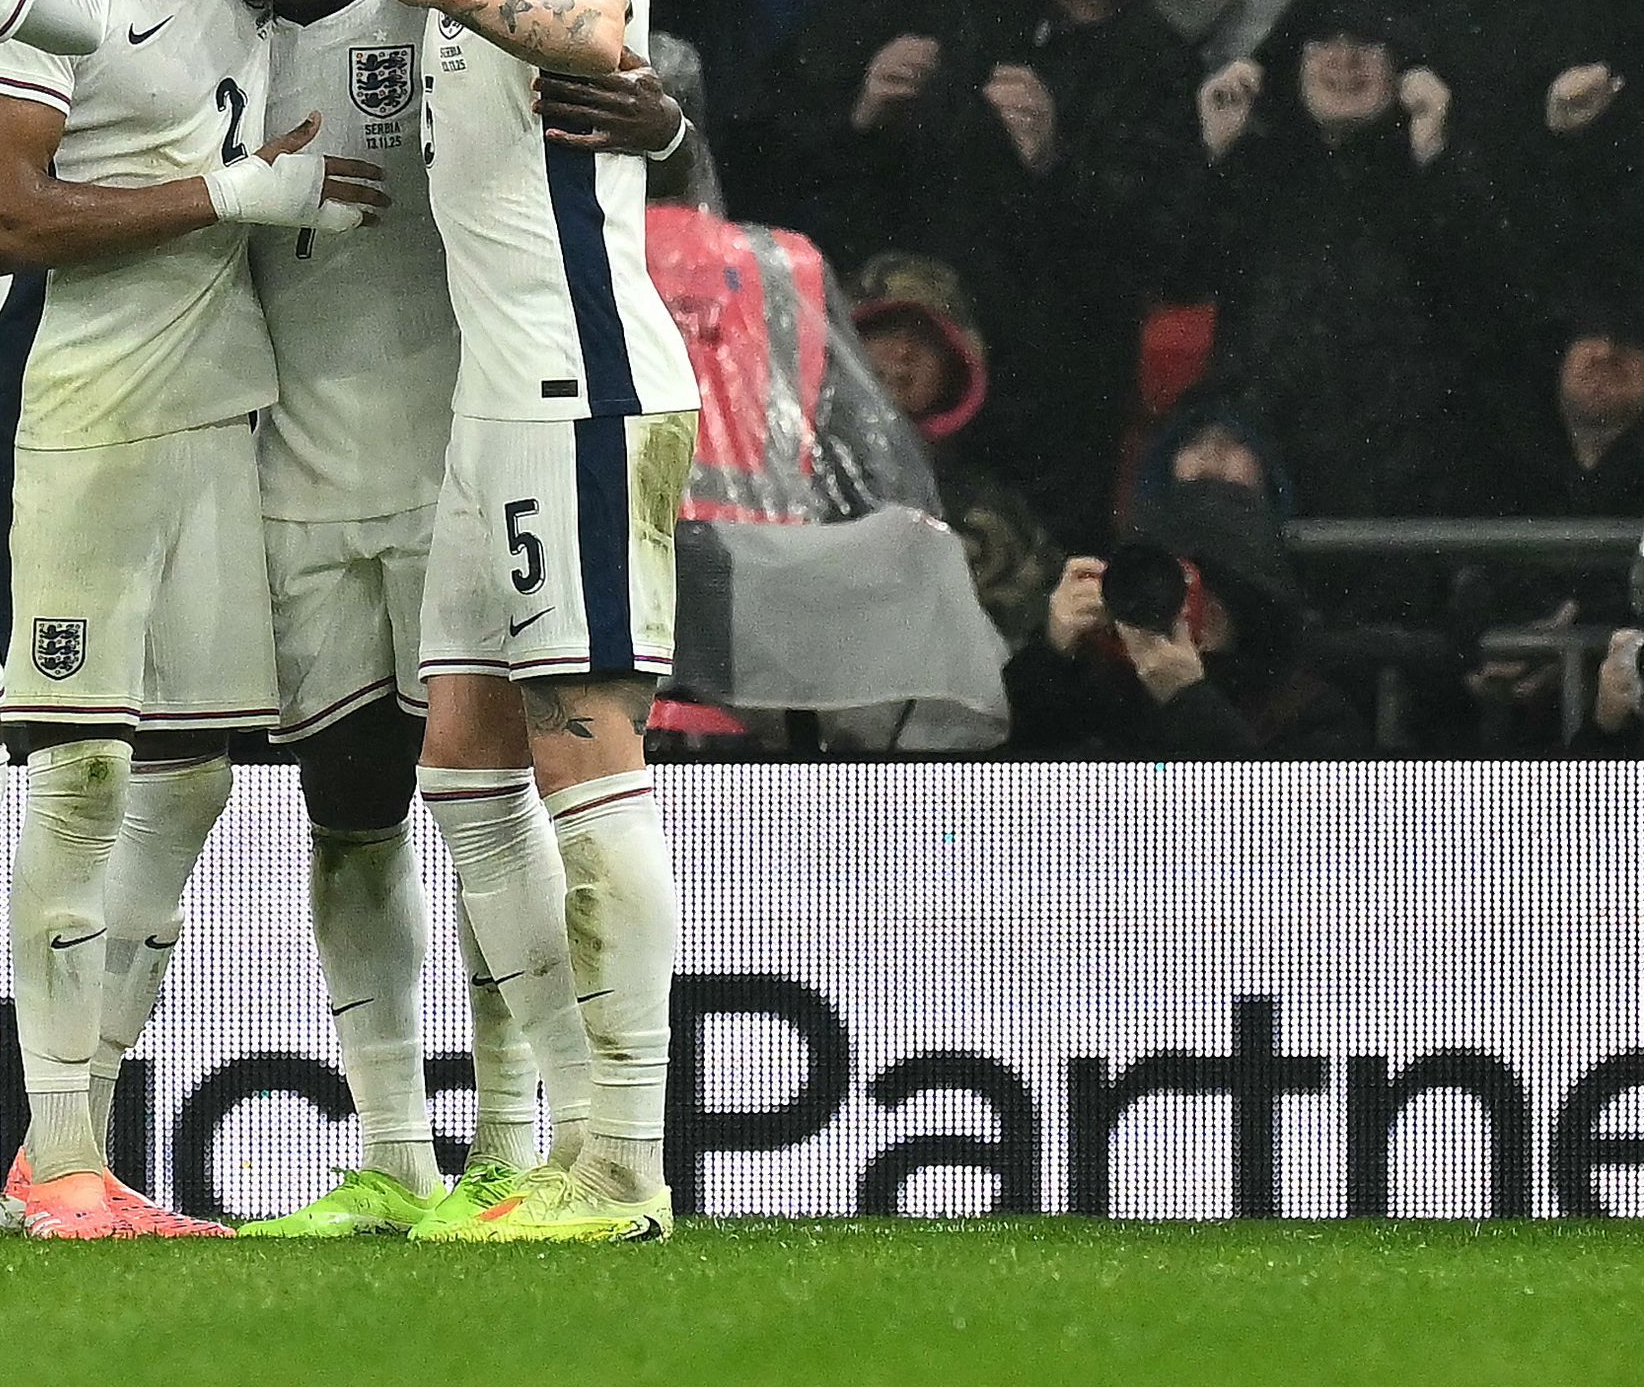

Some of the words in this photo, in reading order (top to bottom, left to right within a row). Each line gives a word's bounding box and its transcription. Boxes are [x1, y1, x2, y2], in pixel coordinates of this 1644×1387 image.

[215, 76, 249, 167] 2
[365, 121, 401, 135] SERBIA
[505, 499, 546, 595] 5
